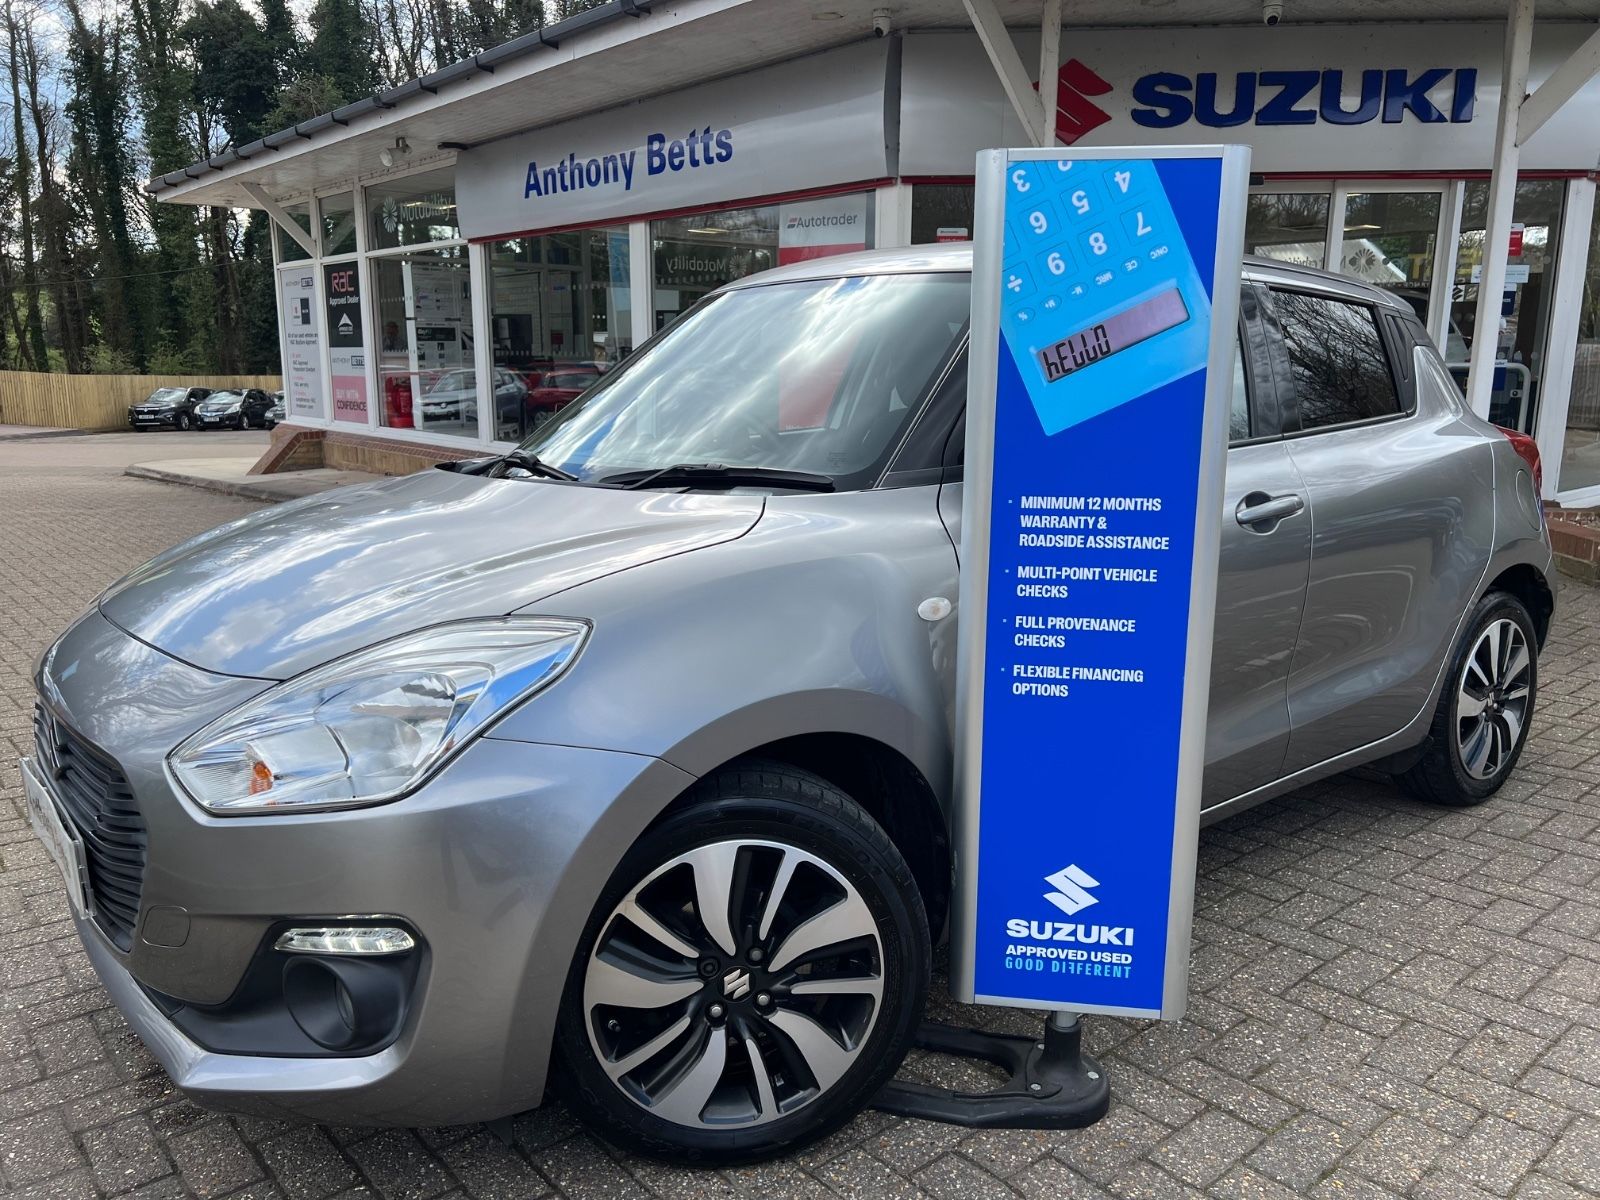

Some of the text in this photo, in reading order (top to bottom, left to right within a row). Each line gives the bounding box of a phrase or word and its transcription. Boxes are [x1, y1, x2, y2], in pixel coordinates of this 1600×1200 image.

[1131, 68, 1478, 128] SUZUKI
[524, 126, 734, 199] Anthony Betts
[1113, 171, 1131, 193] 4
[1071, 190, 1090, 215] 5
[796, 213, 858, 229] Autotrader
[1135, 212, 1152, 237] 7
[1089, 232, 1108, 255] 8
[1021, 496, 1162, 511] MINIMUM 12 MONTHS
[1020, 515, 1107, 529] WARRANTY &
[1019, 534, 1169, 550] ROADSIDE ASSISTANCE
[1017, 566, 1157, 582] MULTI-POINT VEHICLE
[1016, 584, 1068, 598] CHECKS
[1015, 616, 1136, 632] FULL PROVENANCE
[1014, 634, 1065, 648] CHECKS
[1013, 665, 1144, 682] FLEXIBLE FINANCING
[1012, 683, 1069, 697] OPTIONS
[1006, 919, 1134, 946] SUZUKI
[1006, 944, 1132, 964] APPROVED USED
[1005, 956, 1132, 979] GOOD DIFFERENT
